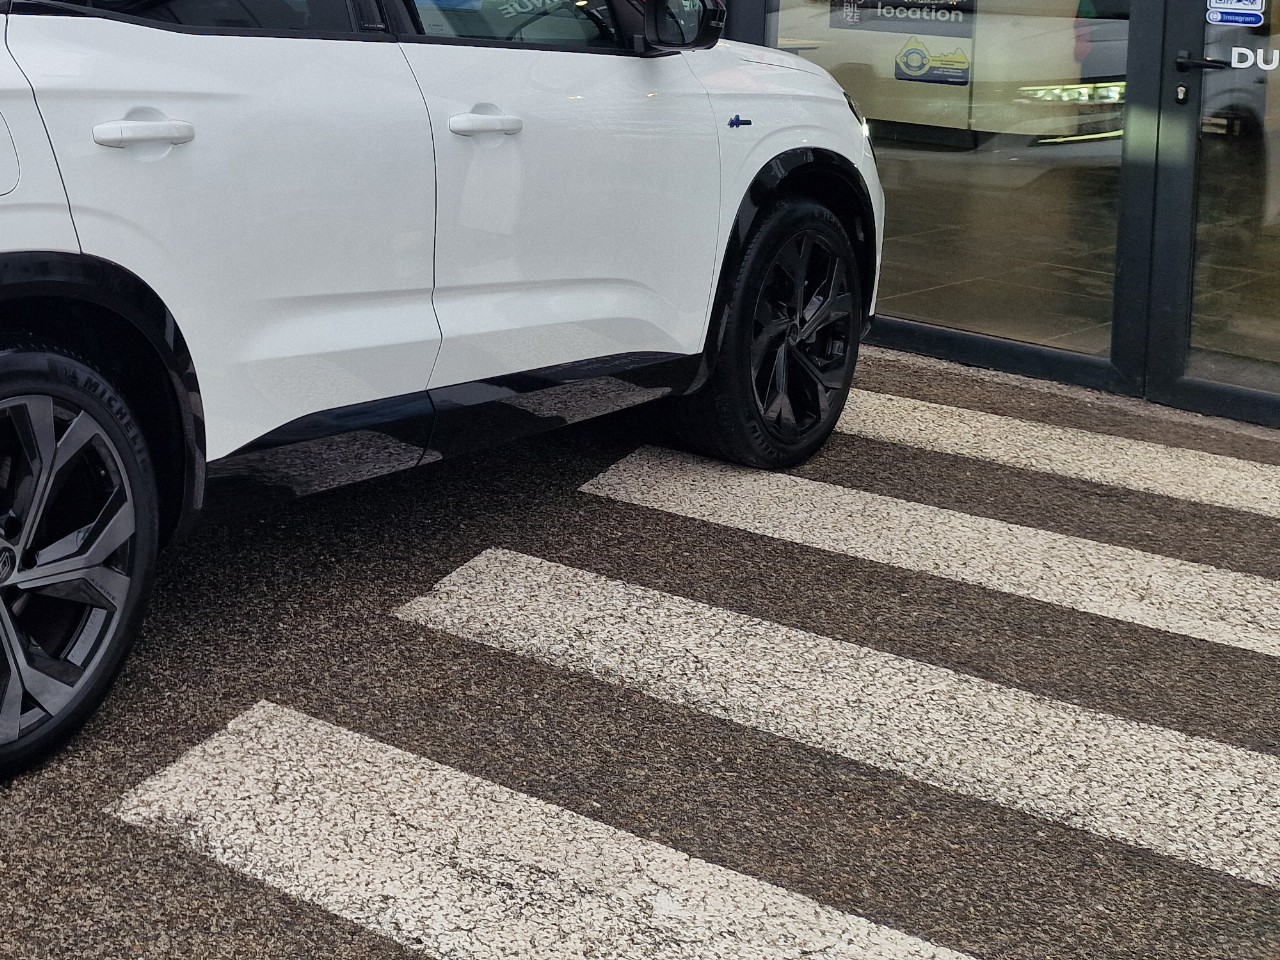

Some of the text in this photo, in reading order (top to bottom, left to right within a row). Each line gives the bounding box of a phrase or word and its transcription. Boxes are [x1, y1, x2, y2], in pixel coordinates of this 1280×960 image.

[876, 1, 963, 23] location
[1222, 14, 1256, 23] Instagram
[1231, 46, 1280, 71] DU
